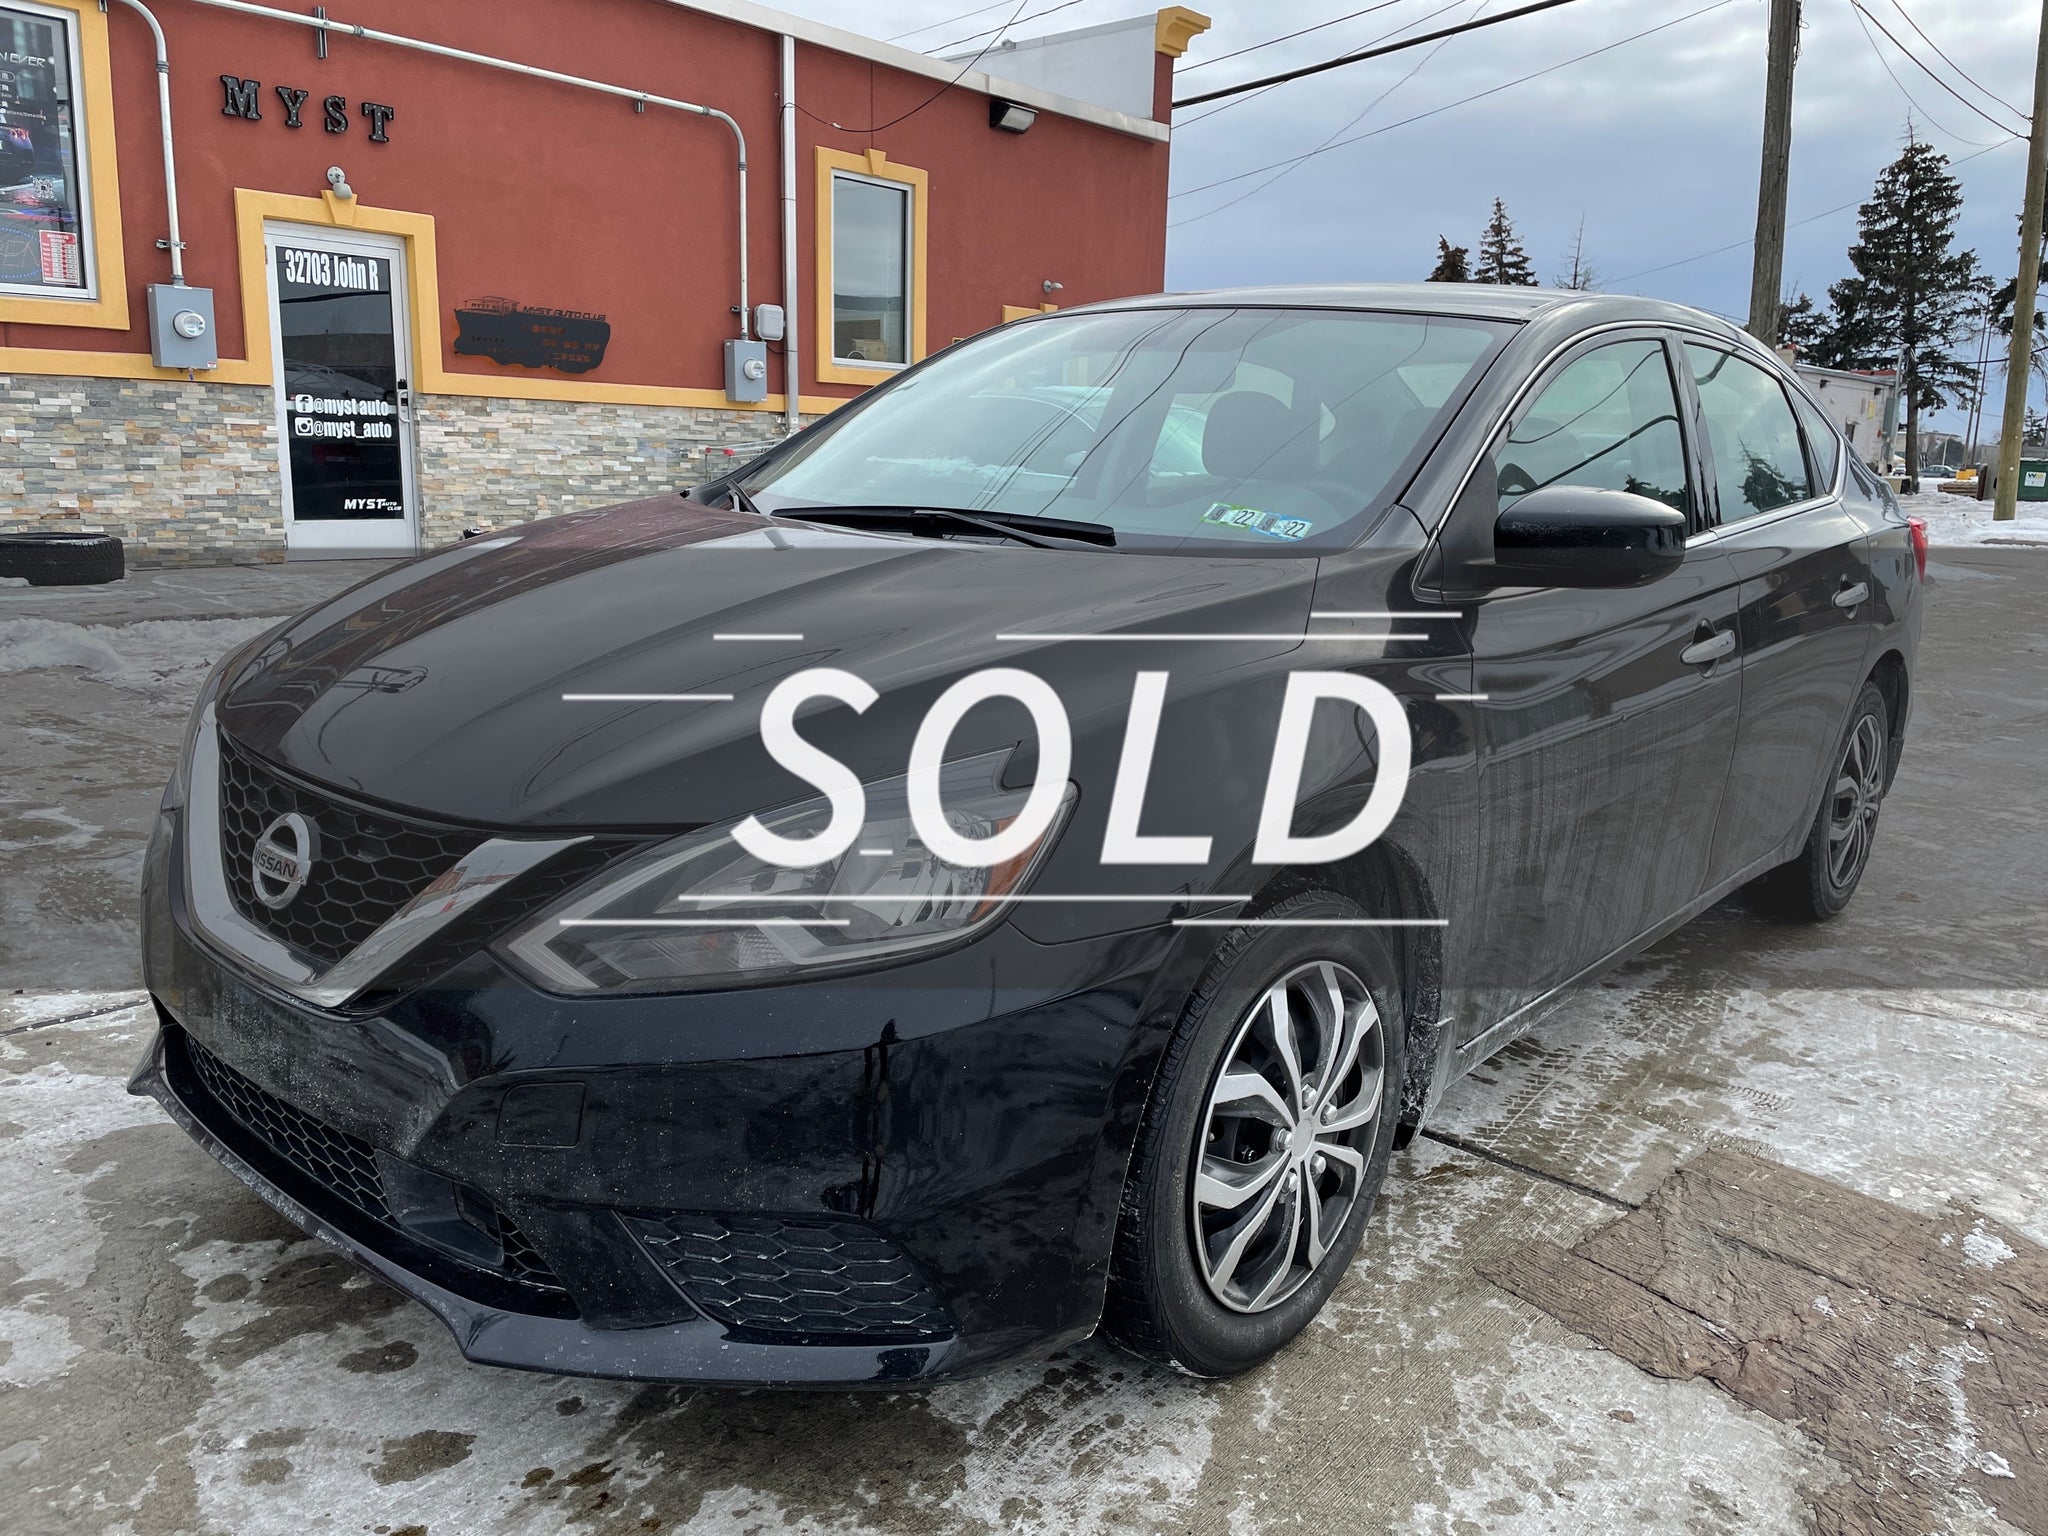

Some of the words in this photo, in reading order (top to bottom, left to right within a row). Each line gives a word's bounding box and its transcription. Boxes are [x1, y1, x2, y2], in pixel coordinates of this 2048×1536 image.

[220, 75, 395, 142] MYST
[285, 249, 331, 286] 32703
[333, 255, 367, 289] John
[368, 259, 379, 291] R
[313, 420, 392, 439] @myst_auto
[344, 498, 386, 510] MYST
[1233, 510, 1255, 526] 22
[1284, 521, 1306, 537] 22
[254, 846, 297, 878] NISSAN
